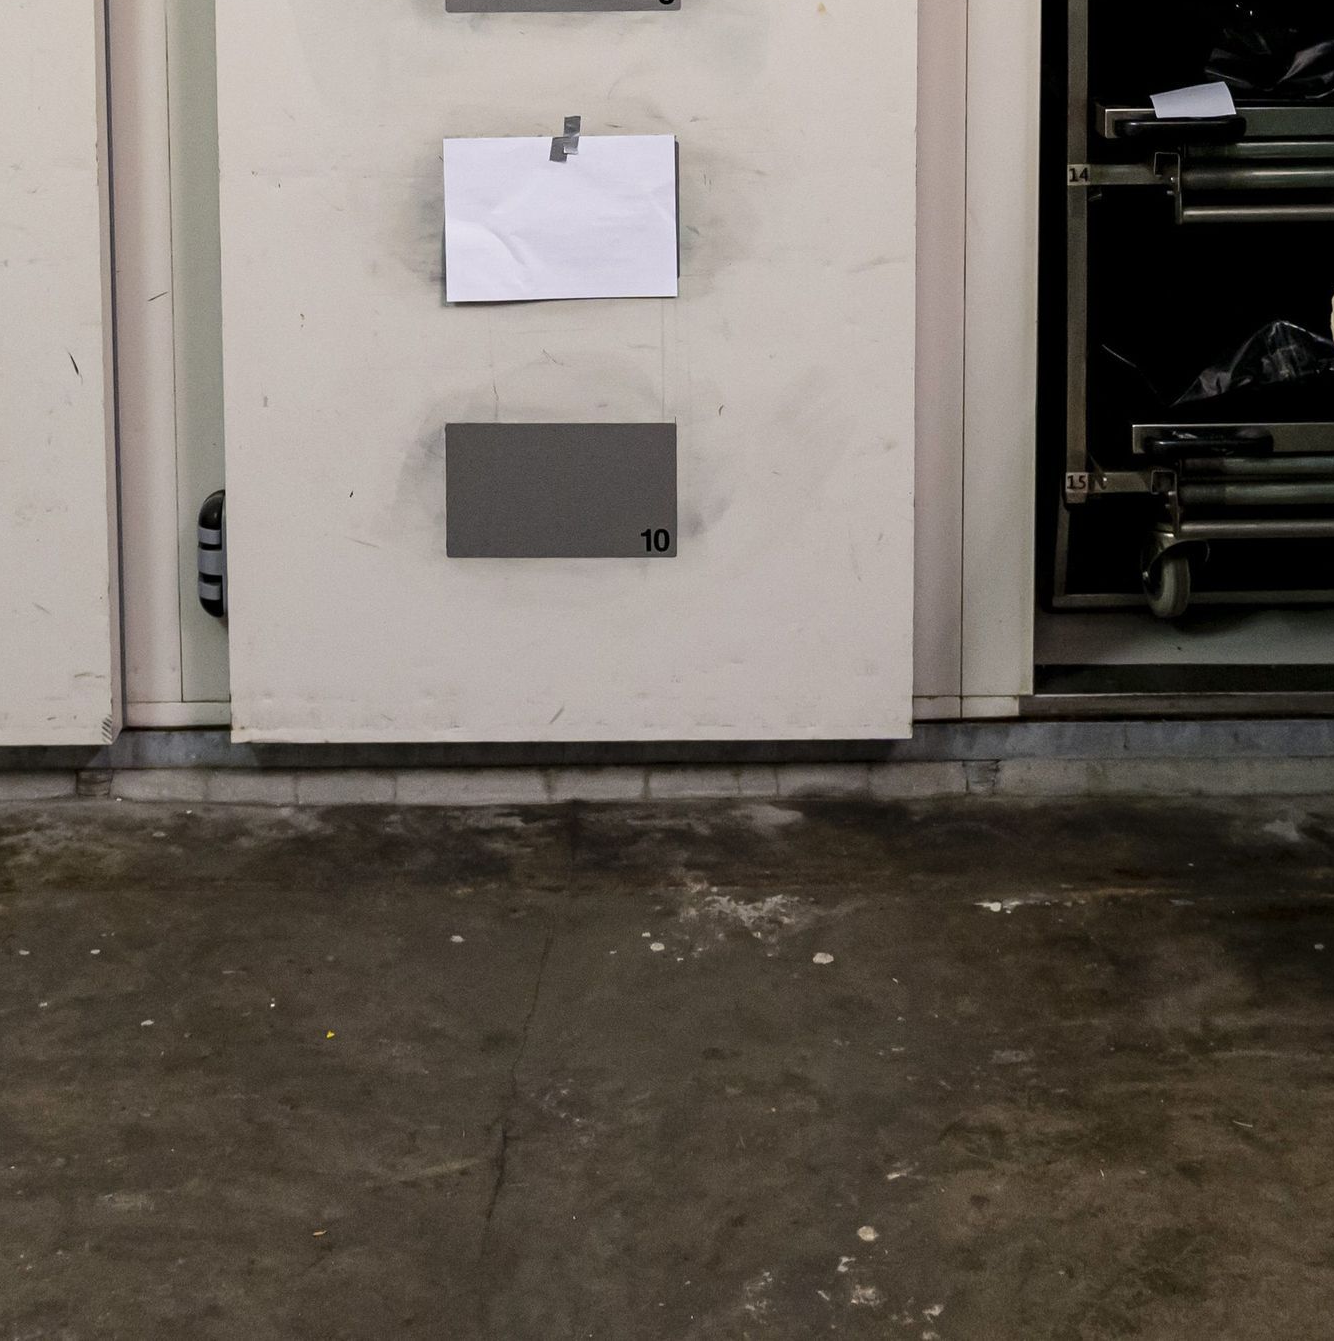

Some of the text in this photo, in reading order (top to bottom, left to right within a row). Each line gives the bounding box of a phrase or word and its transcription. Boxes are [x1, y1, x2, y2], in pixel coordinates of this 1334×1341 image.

[1069, 167, 1089, 182] 14
[1067, 475, 1087, 490] 15
[640, 528, 670, 553] 10
